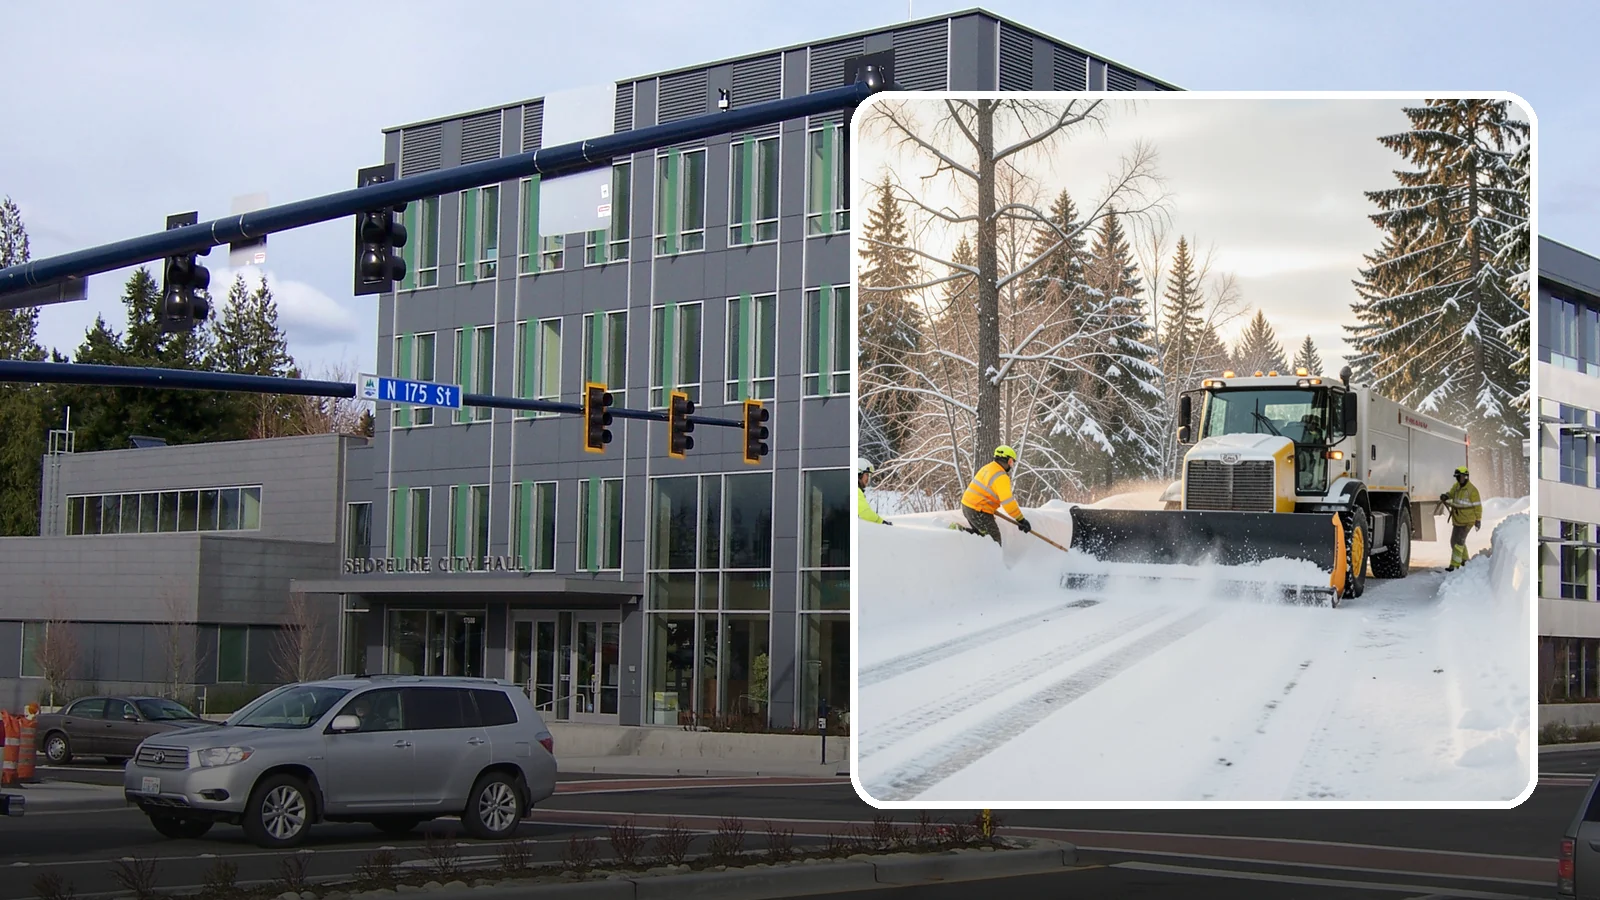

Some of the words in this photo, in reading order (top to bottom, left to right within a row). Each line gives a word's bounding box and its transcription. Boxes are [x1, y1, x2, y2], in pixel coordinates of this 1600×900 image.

[387, 380, 396, 400] N
[405, 382, 427, 403] 175
[436, 386, 452, 406] St
[344, 557, 432, 574] SHORELINE
[438, 556, 476, 572] CITY
[484, 555, 526, 572] HALL
